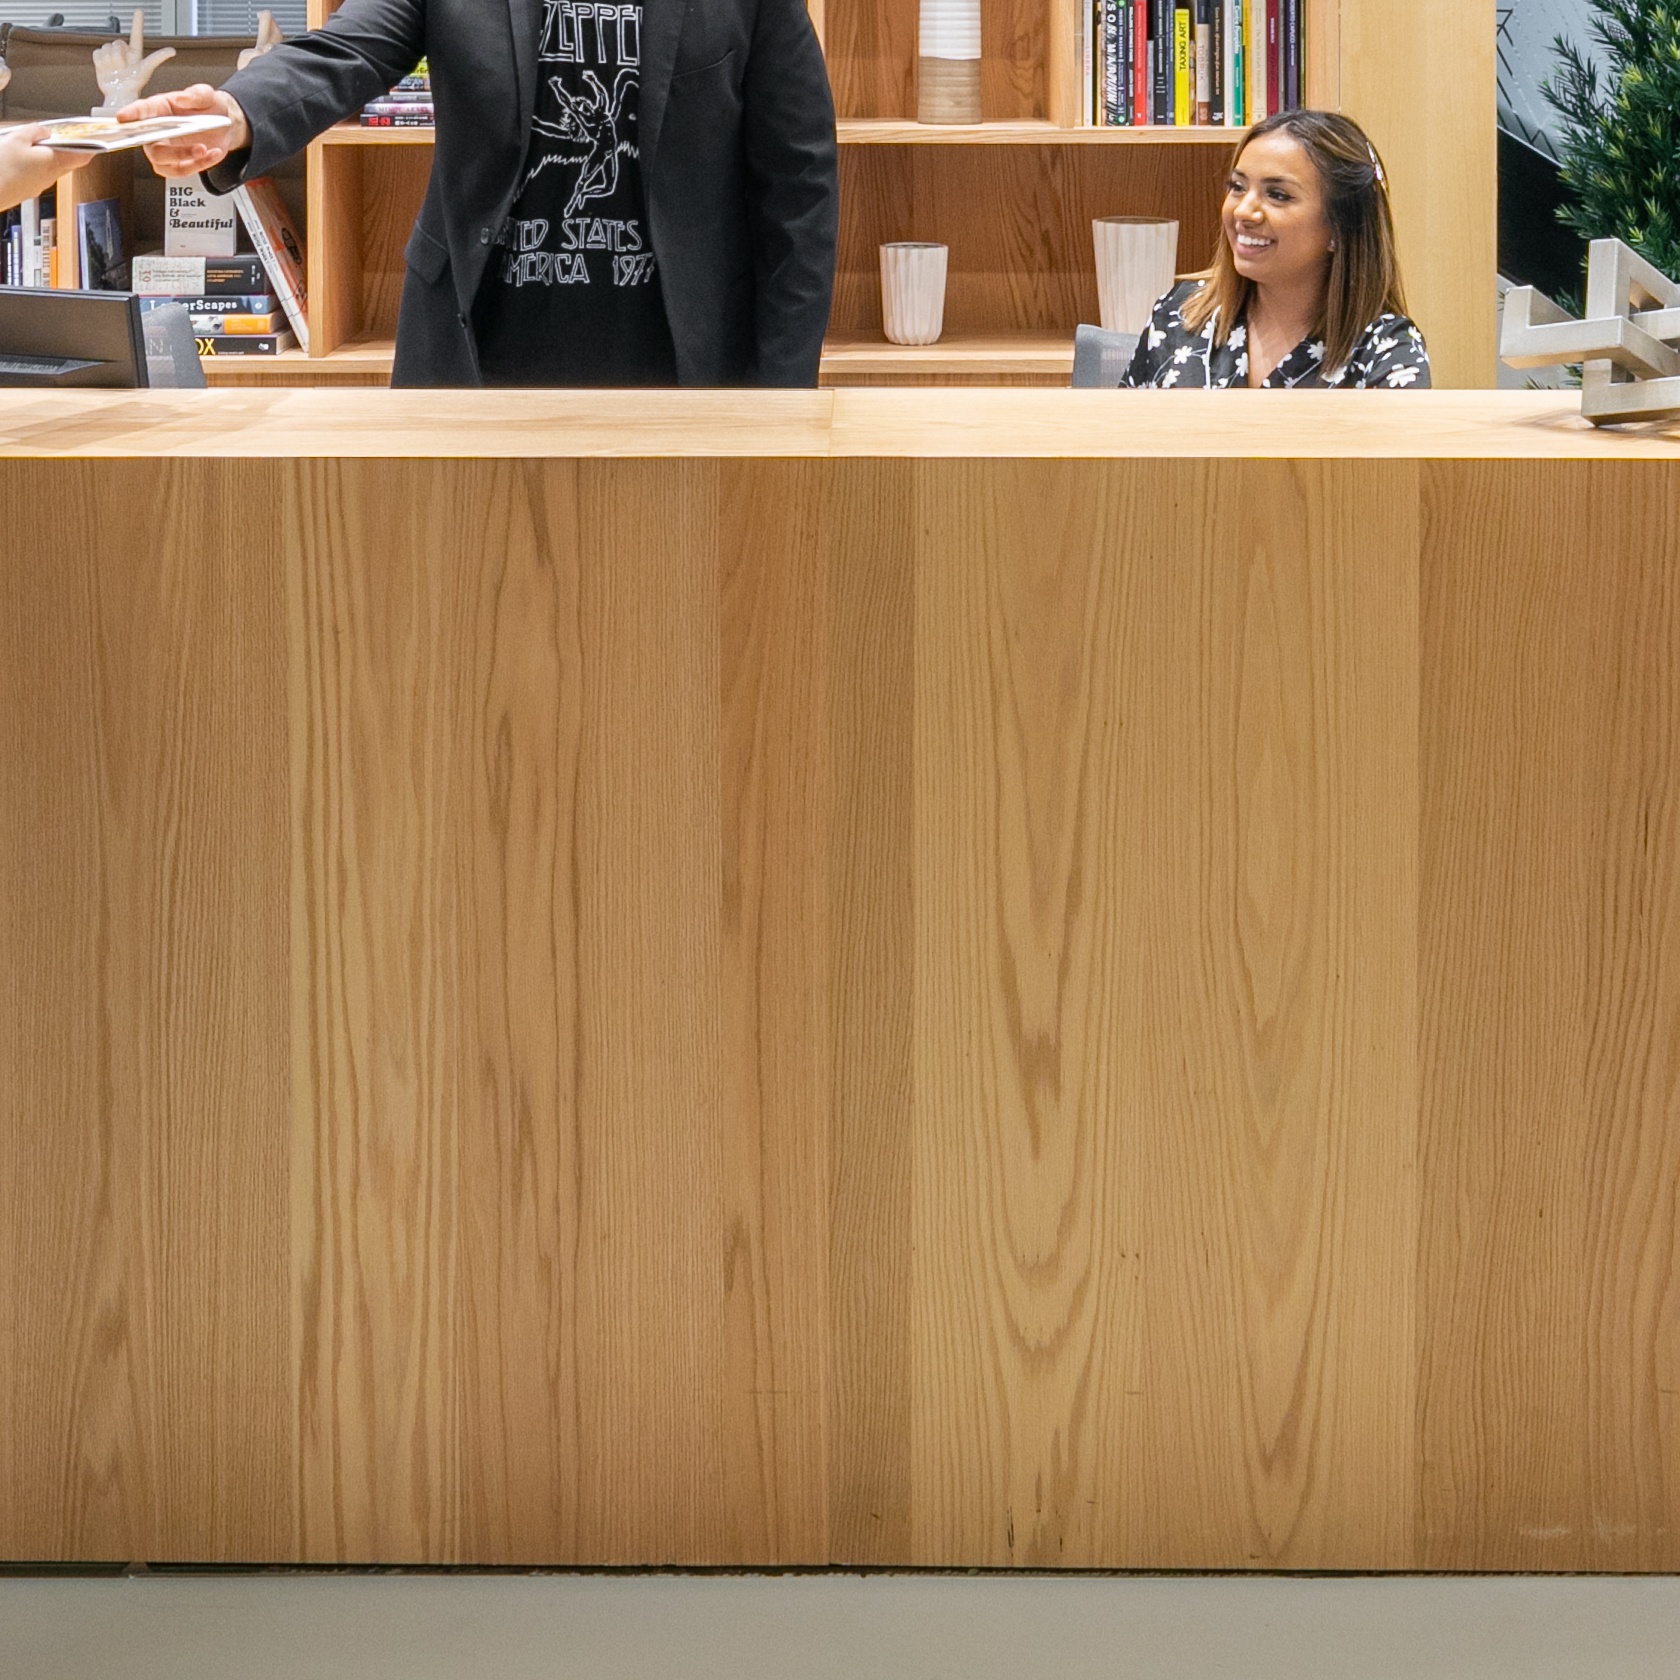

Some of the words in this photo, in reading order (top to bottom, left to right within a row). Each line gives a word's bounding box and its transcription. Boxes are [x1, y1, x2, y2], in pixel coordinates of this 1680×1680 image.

[1179, 20, 1188, 38] ART
[1179, 39, 1188, 71] TAXING
[1197, 44, 1205, 81] TOBRUK
[169, 186, 193, 196] BIG
[169, 197, 206, 207] Black
[169, 208, 180, 218] &
[169, 218, 233, 230] Beautiful
[561, 218, 642, 252] STATES
[504, 252, 590, 287] MERICA
